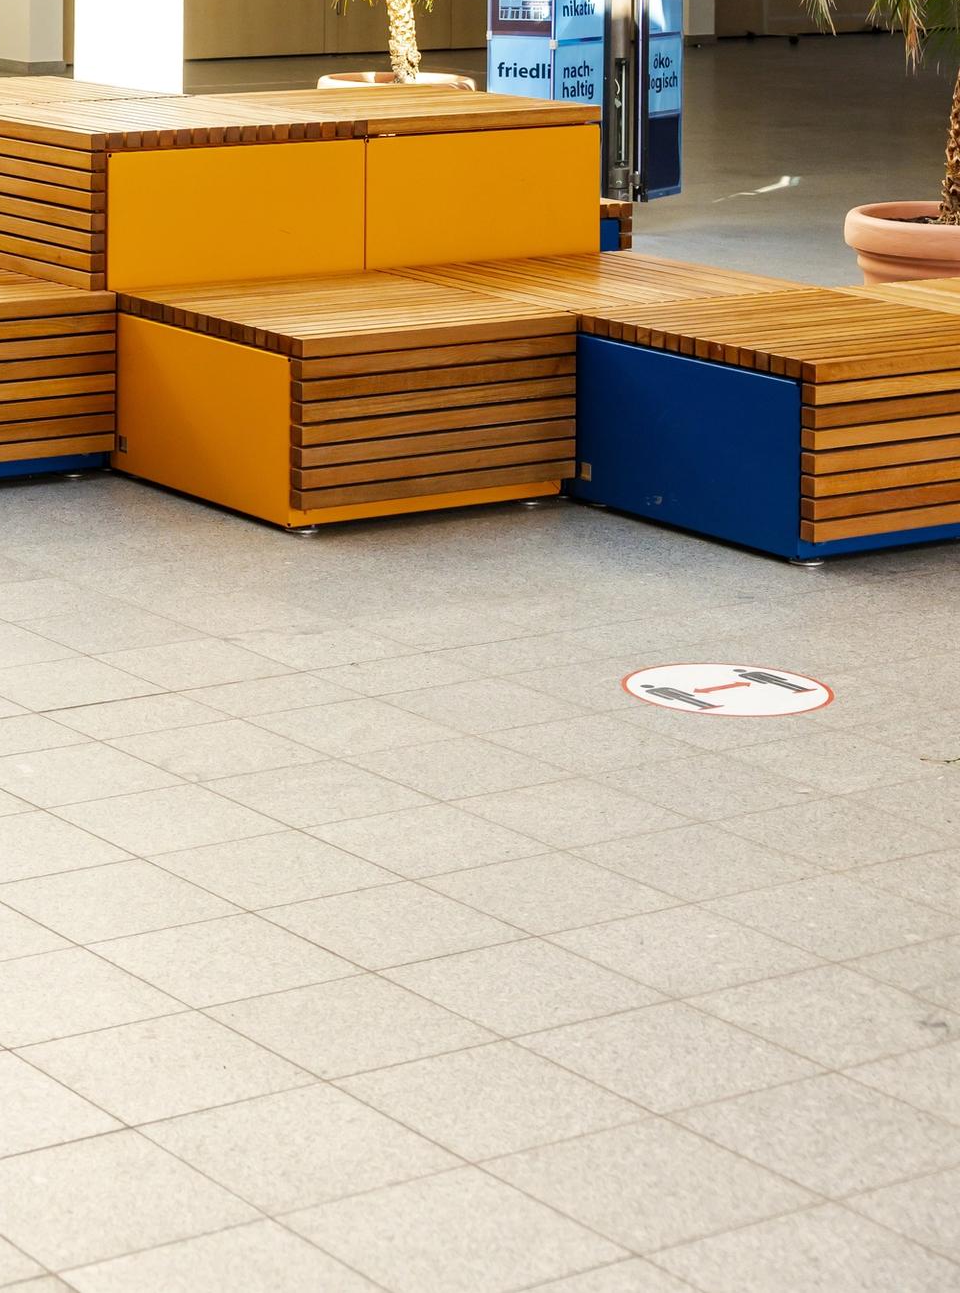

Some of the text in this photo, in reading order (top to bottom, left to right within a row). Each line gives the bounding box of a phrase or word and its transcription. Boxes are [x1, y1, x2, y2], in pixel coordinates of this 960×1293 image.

[562, 0, 596, 17] nikativ
[653, 52, 673, 69] öko-
[563, 61, 594, 78] nach-
[562, 80, 594, 99] haltig
